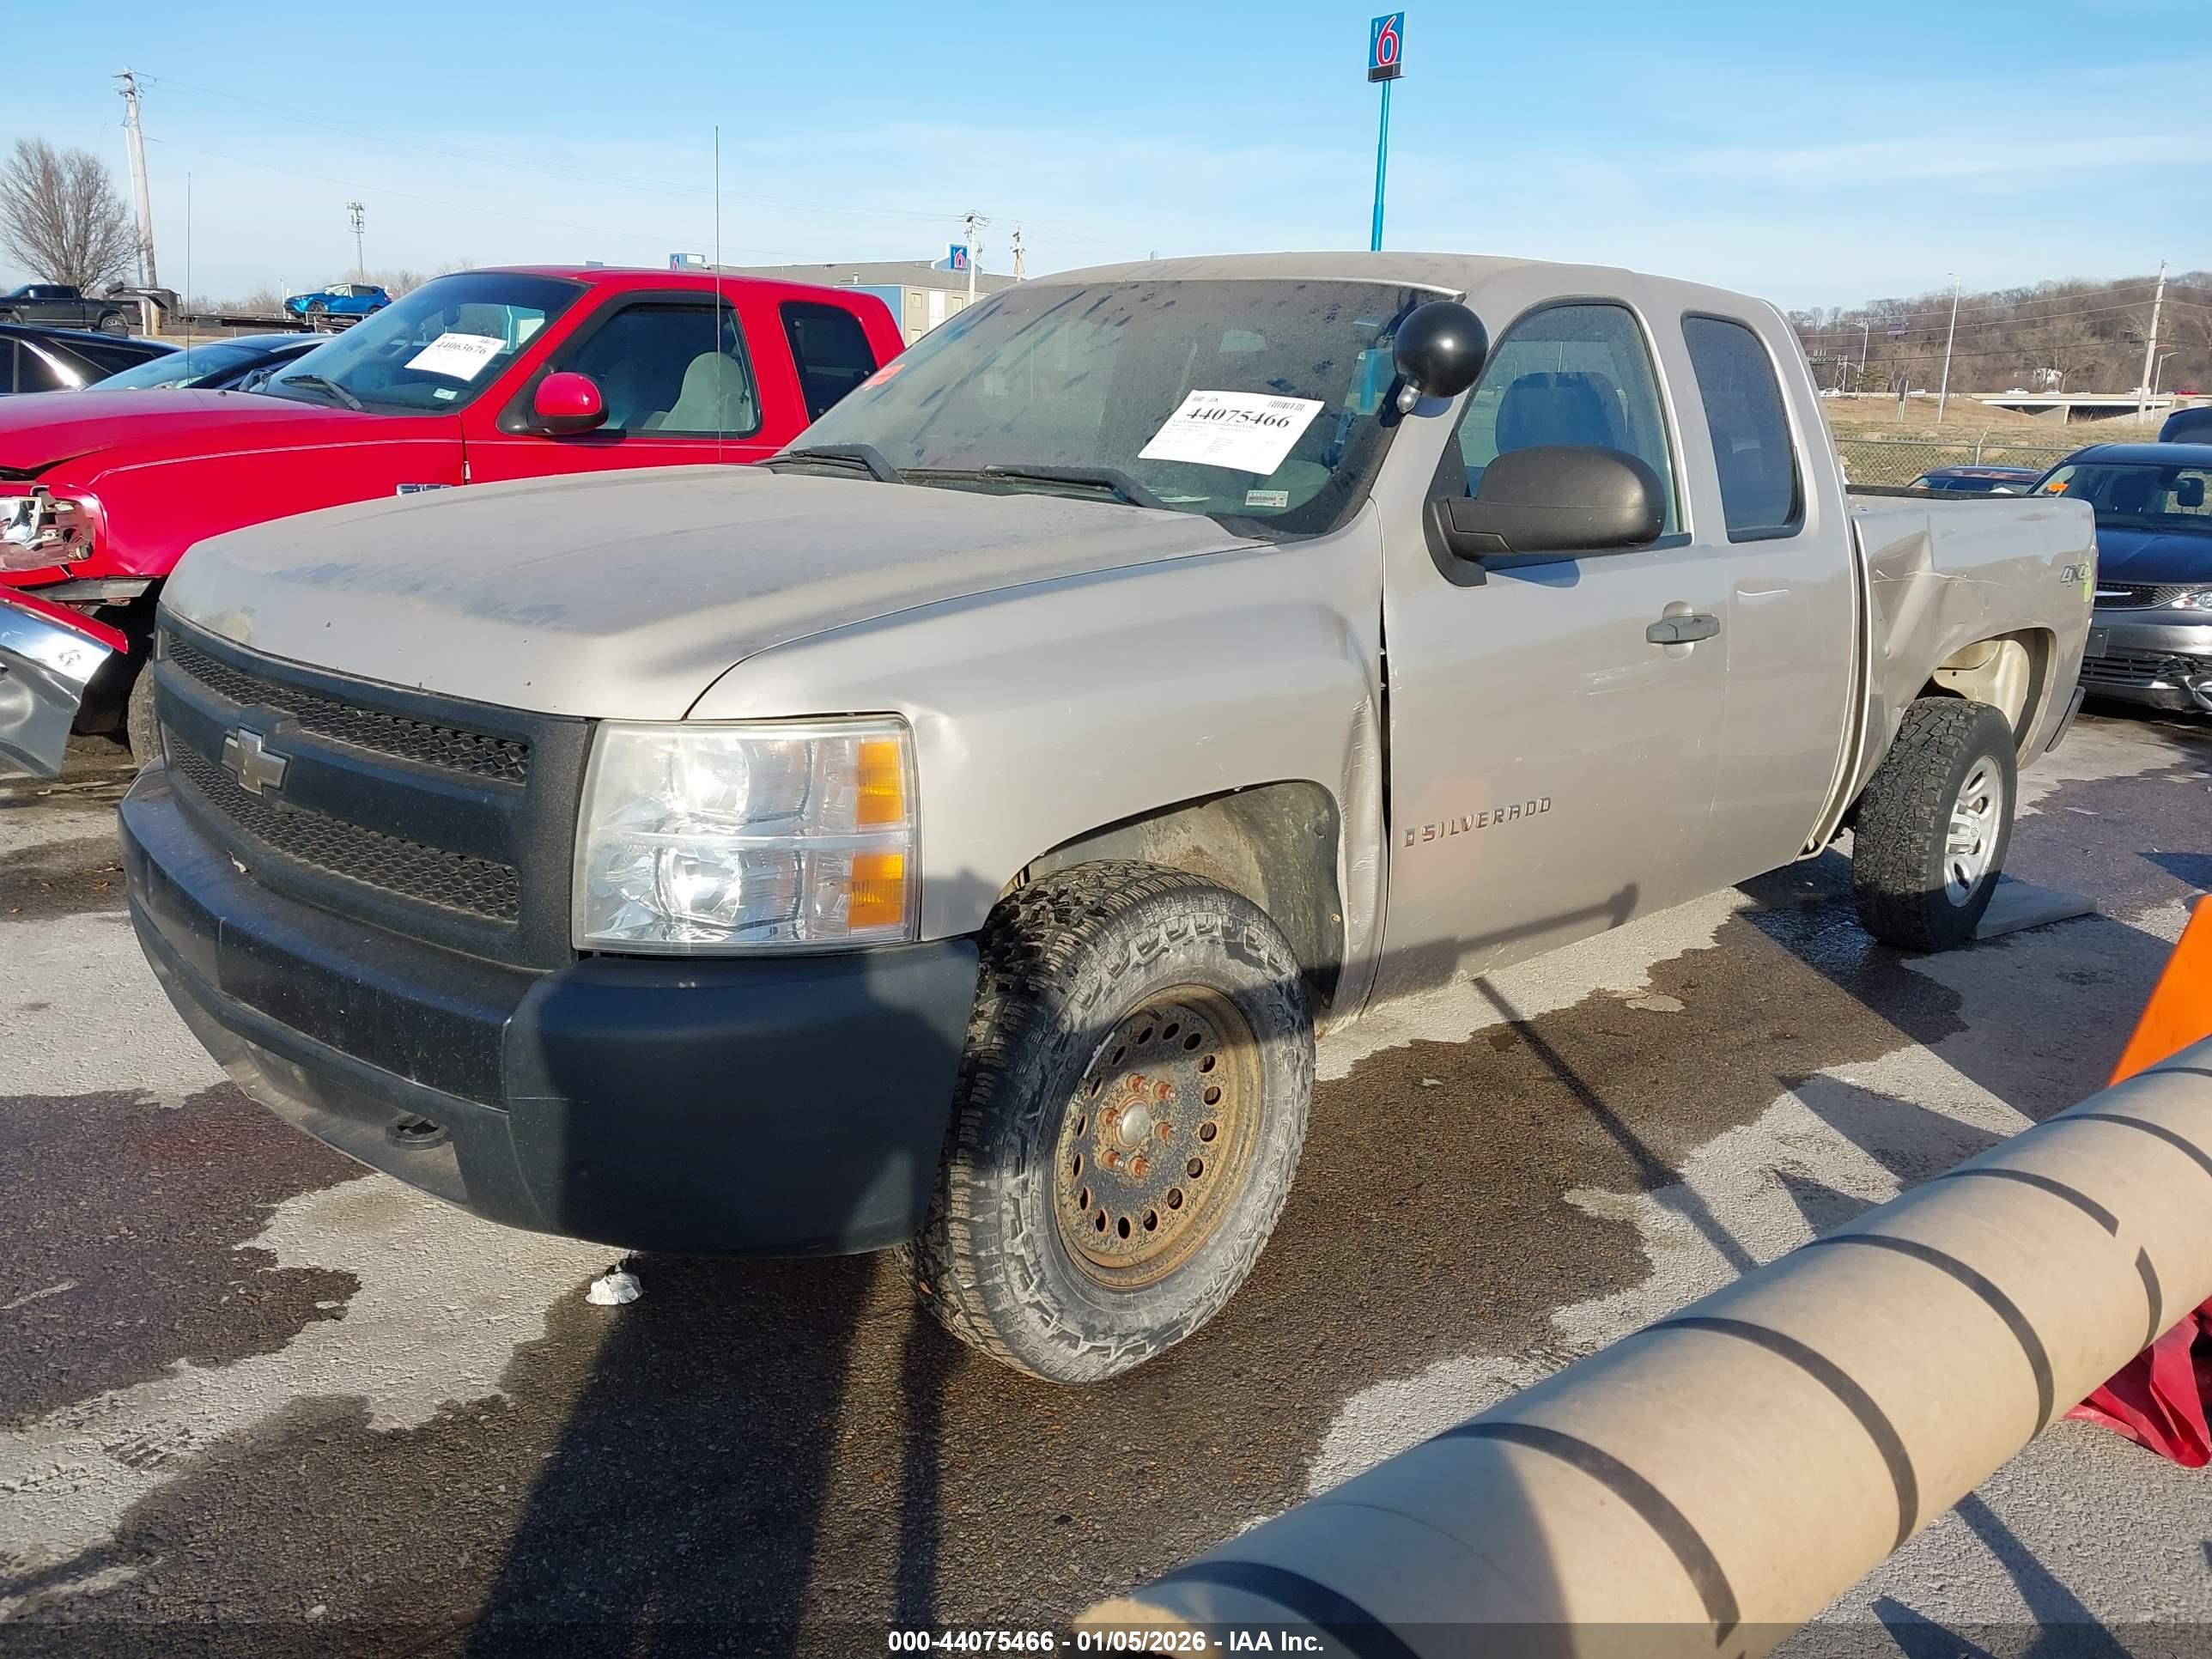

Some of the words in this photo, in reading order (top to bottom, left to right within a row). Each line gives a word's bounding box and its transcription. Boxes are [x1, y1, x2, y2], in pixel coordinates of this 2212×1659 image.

[1376, 15, 1399, 66] 6
[954, 249, 967, 269] 6
[1186, 407, 1294, 428] 44075466
[1421, 797, 1552, 842] SILVERADO
[1211, 1085, 1296, 1289] TERRAIN
